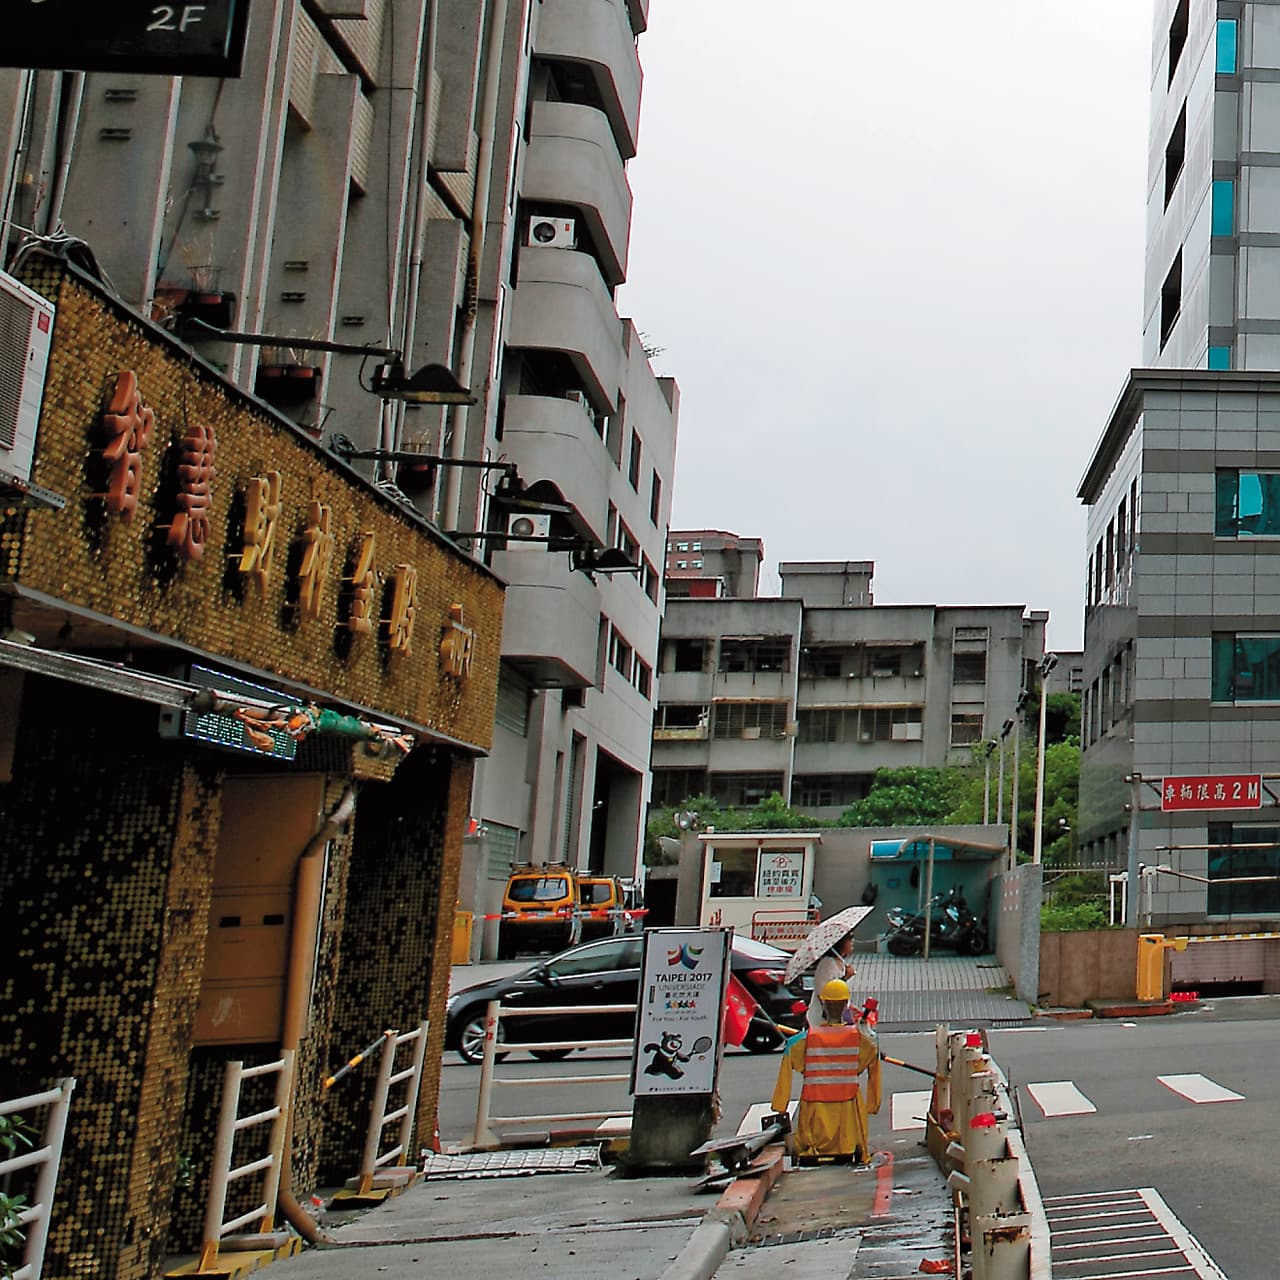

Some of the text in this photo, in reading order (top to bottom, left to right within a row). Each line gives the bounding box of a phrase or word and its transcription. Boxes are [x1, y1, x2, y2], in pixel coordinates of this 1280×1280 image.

[147, 5, 206, 33] 2F
[655, 972, 713, 983] TAIPEI 2017
